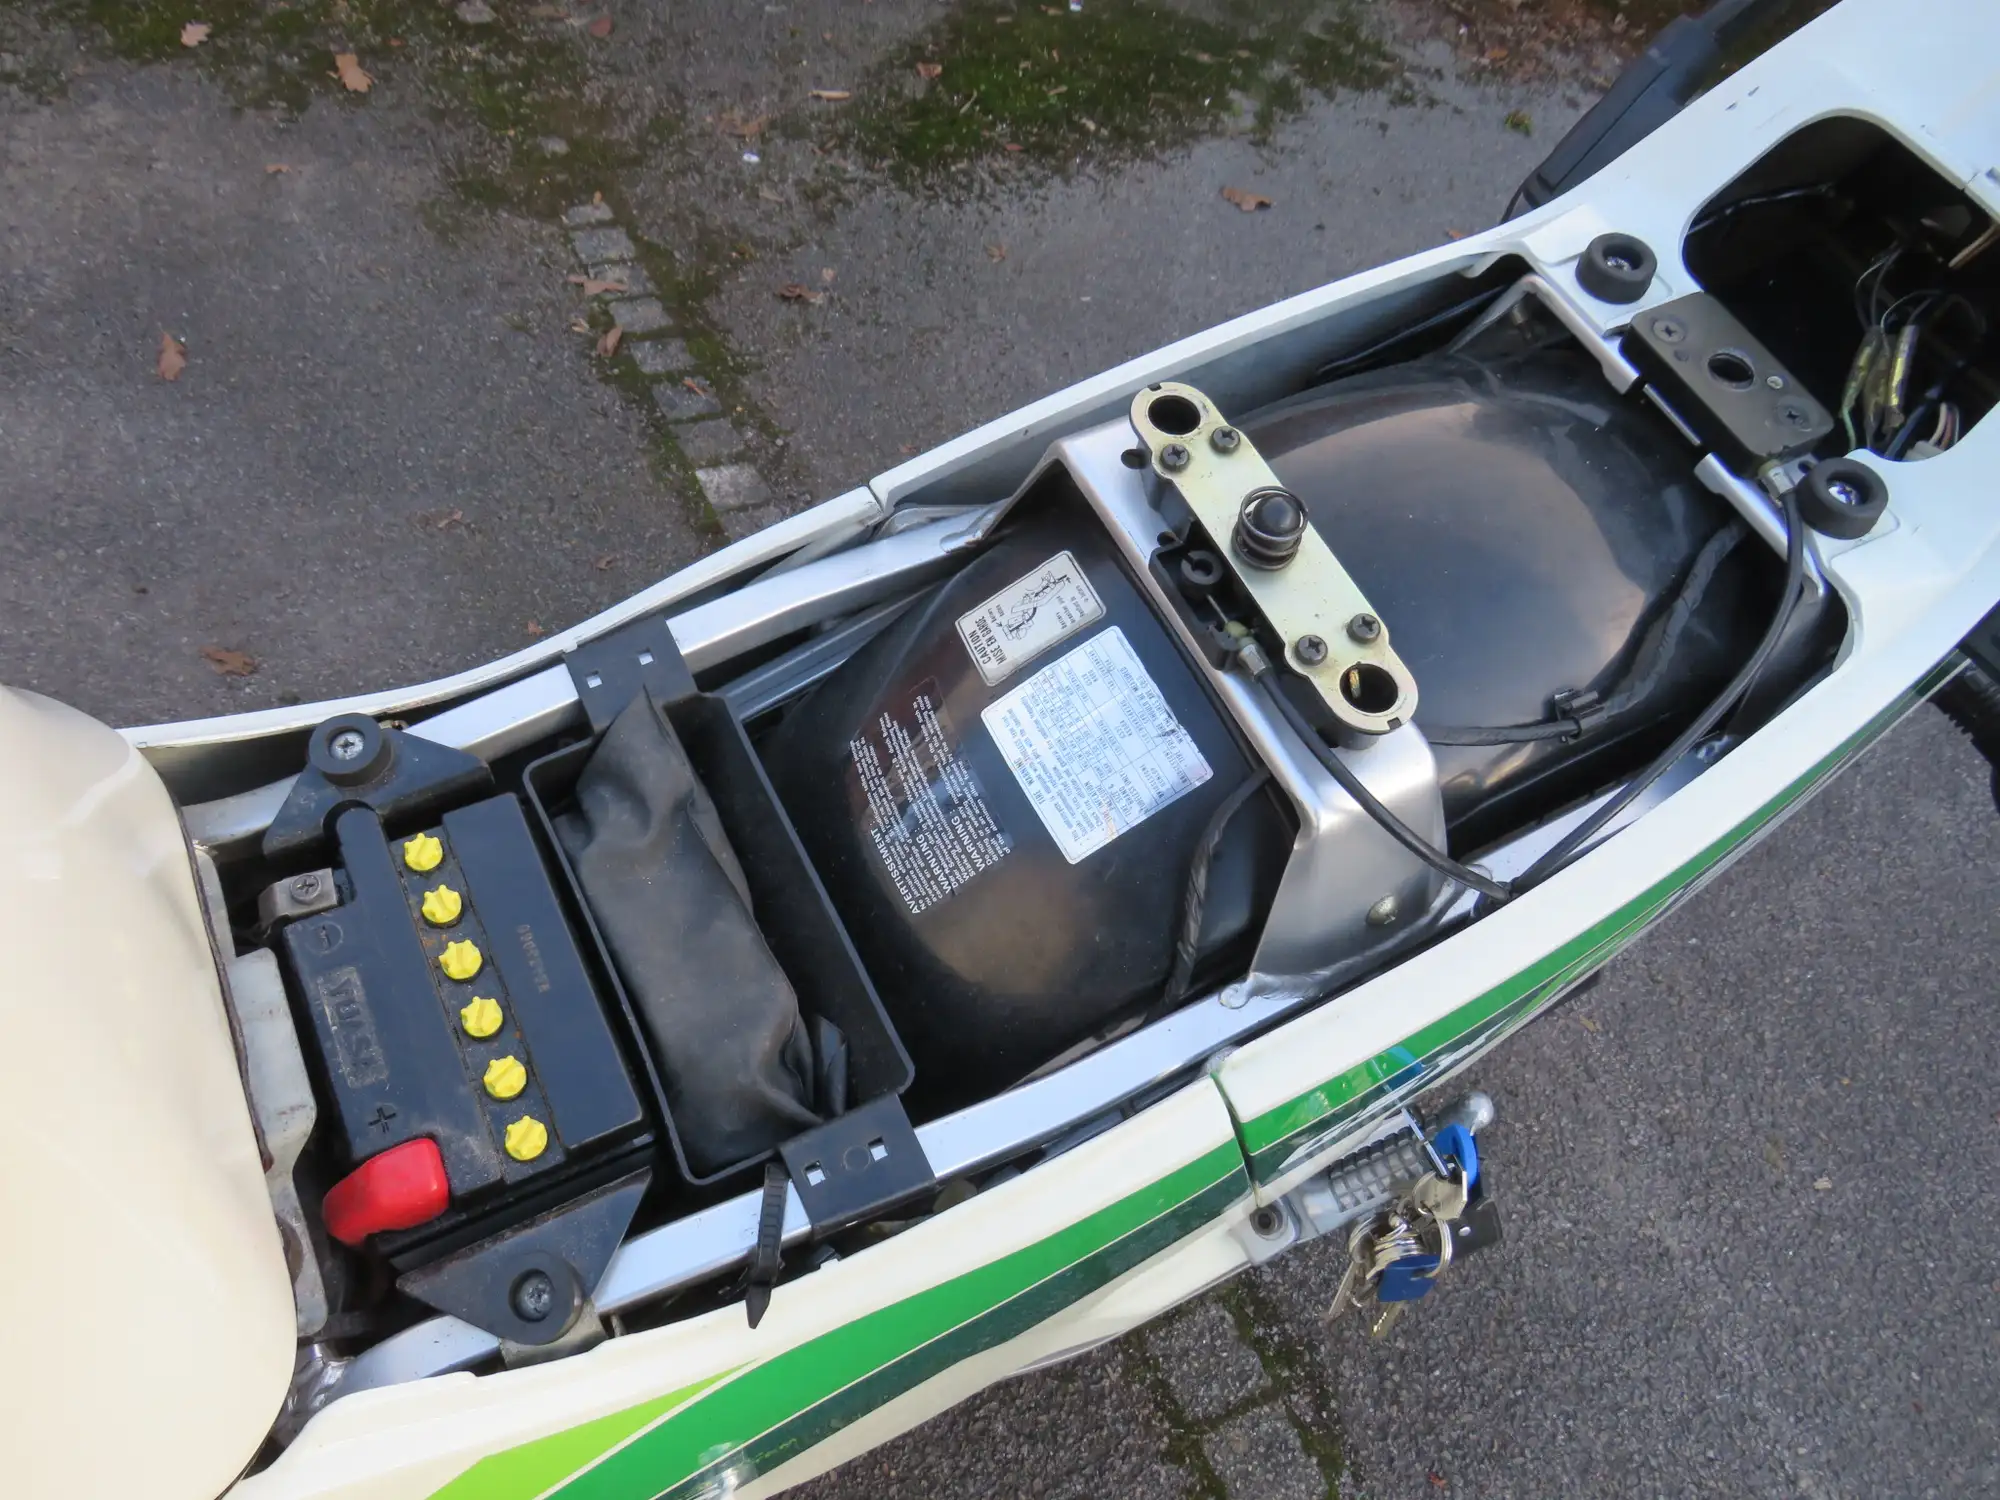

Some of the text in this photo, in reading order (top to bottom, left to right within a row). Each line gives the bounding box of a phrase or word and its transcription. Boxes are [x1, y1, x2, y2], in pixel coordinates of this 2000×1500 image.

[967, 629, 992, 665] CAUTION
[974, 615, 1007, 665] MISE EN GARDE
[1119, 665, 1140, 692] MEASURED
[915, 694, 925, 710] could
[1136, 692, 1145, 701] BE
[1144, 688, 1155, 700] ARE
[913, 708, 923, 724] such
[1141, 699, 1158, 721] SHOULD
[922, 710, 934, 734] warning
[1162, 716, 1173, 727] THE
[926, 741, 935, 754] the
[931, 734, 940, 748] this
[940, 740, 949, 753] the
[931, 753, 939, 762] to
[936, 748, 947, 765] heed
[945, 752, 954, 762] by
[1173, 749, 1185, 763] TIRE
[875, 766, 883, 776] en
[895, 768, 905, 782] wie
[906, 758, 920, 782] wegen
[944, 765, 951, 774] to
[950, 762, 965, 786] caused
[859, 773, 869, 792] telles
[867, 778, 876, 791] pas
[872, 775, 880, 785] un
[879, 775, 893, 801] pourrait
[935, 761, 959, 805] modifications
[948, 773, 962, 797] Failure
[1012, 756, 1046, 805] TIRE WARNING
[872, 790, 881, 806] tient
[876, 785, 884, 797] par
[900, 781, 914, 803] Weise
[915, 780, 928, 801] Unfall
[1082, 779, 1105, 809] INFLATION
[1094, 783, 1116, 812] PRESSURE
[1117, 784, 1134, 806] BRAND
[962, 786, 980, 814] accident
[865, 791, 886, 833] modifications
[878, 805, 885, 816] ne
[910, 802, 923, 823] keiner
[925, 800, 938, 822] einem
[956, 804, 967, 819] any
[966, 780, 1010, 855] of the aluminum alloy
[1100, 808, 1113, 823] TIRE
[1119, 803, 1132, 817] TIRE
[935, 822, 942, 831] zu
[977, 815, 986, 825] an
[889, 815, 905, 844] accident
[924, 830, 935, 846] darf
[964, 819, 978, 840] make
[977, 828, 984, 837] or
[983, 825, 991, 835] in
[883, 833, 891, 844] de
[940, 831, 952, 849] kann
[949, 813, 986, 872] WARNING
[951, 839, 962, 854] des
[975, 840, 985, 853] not
[988, 836, 1004, 858] result
[901, 842, 910, 853] un
[909, 844, 925, 868] alliage
[931, 829, 955, 868] Schweißen
[981, 837, 999, 862] drilling
[888, 844, 906, 875] effectuer
[902, 859, 911, 869] au
[915, 832, 952, 894] WARNUNG
[931, 844, 950, 875] Rahmen
[949, 848, 970, 881] Warnung
[982, 853, 992, 866] Do
[871, 827, 920, 916] AVERTISSEMENT
[922, 868, 931, 879] en
[951, 867, 964, 884] oder
[903, 873, 920, 898] jamais
[908, 869, 927, 896] soudure
[928, 879, 943, 899] cadre
[946, 873, 958, 888] Der
[916, 897, 926, 910] Ne
[923, 895, 932, 906] ou
